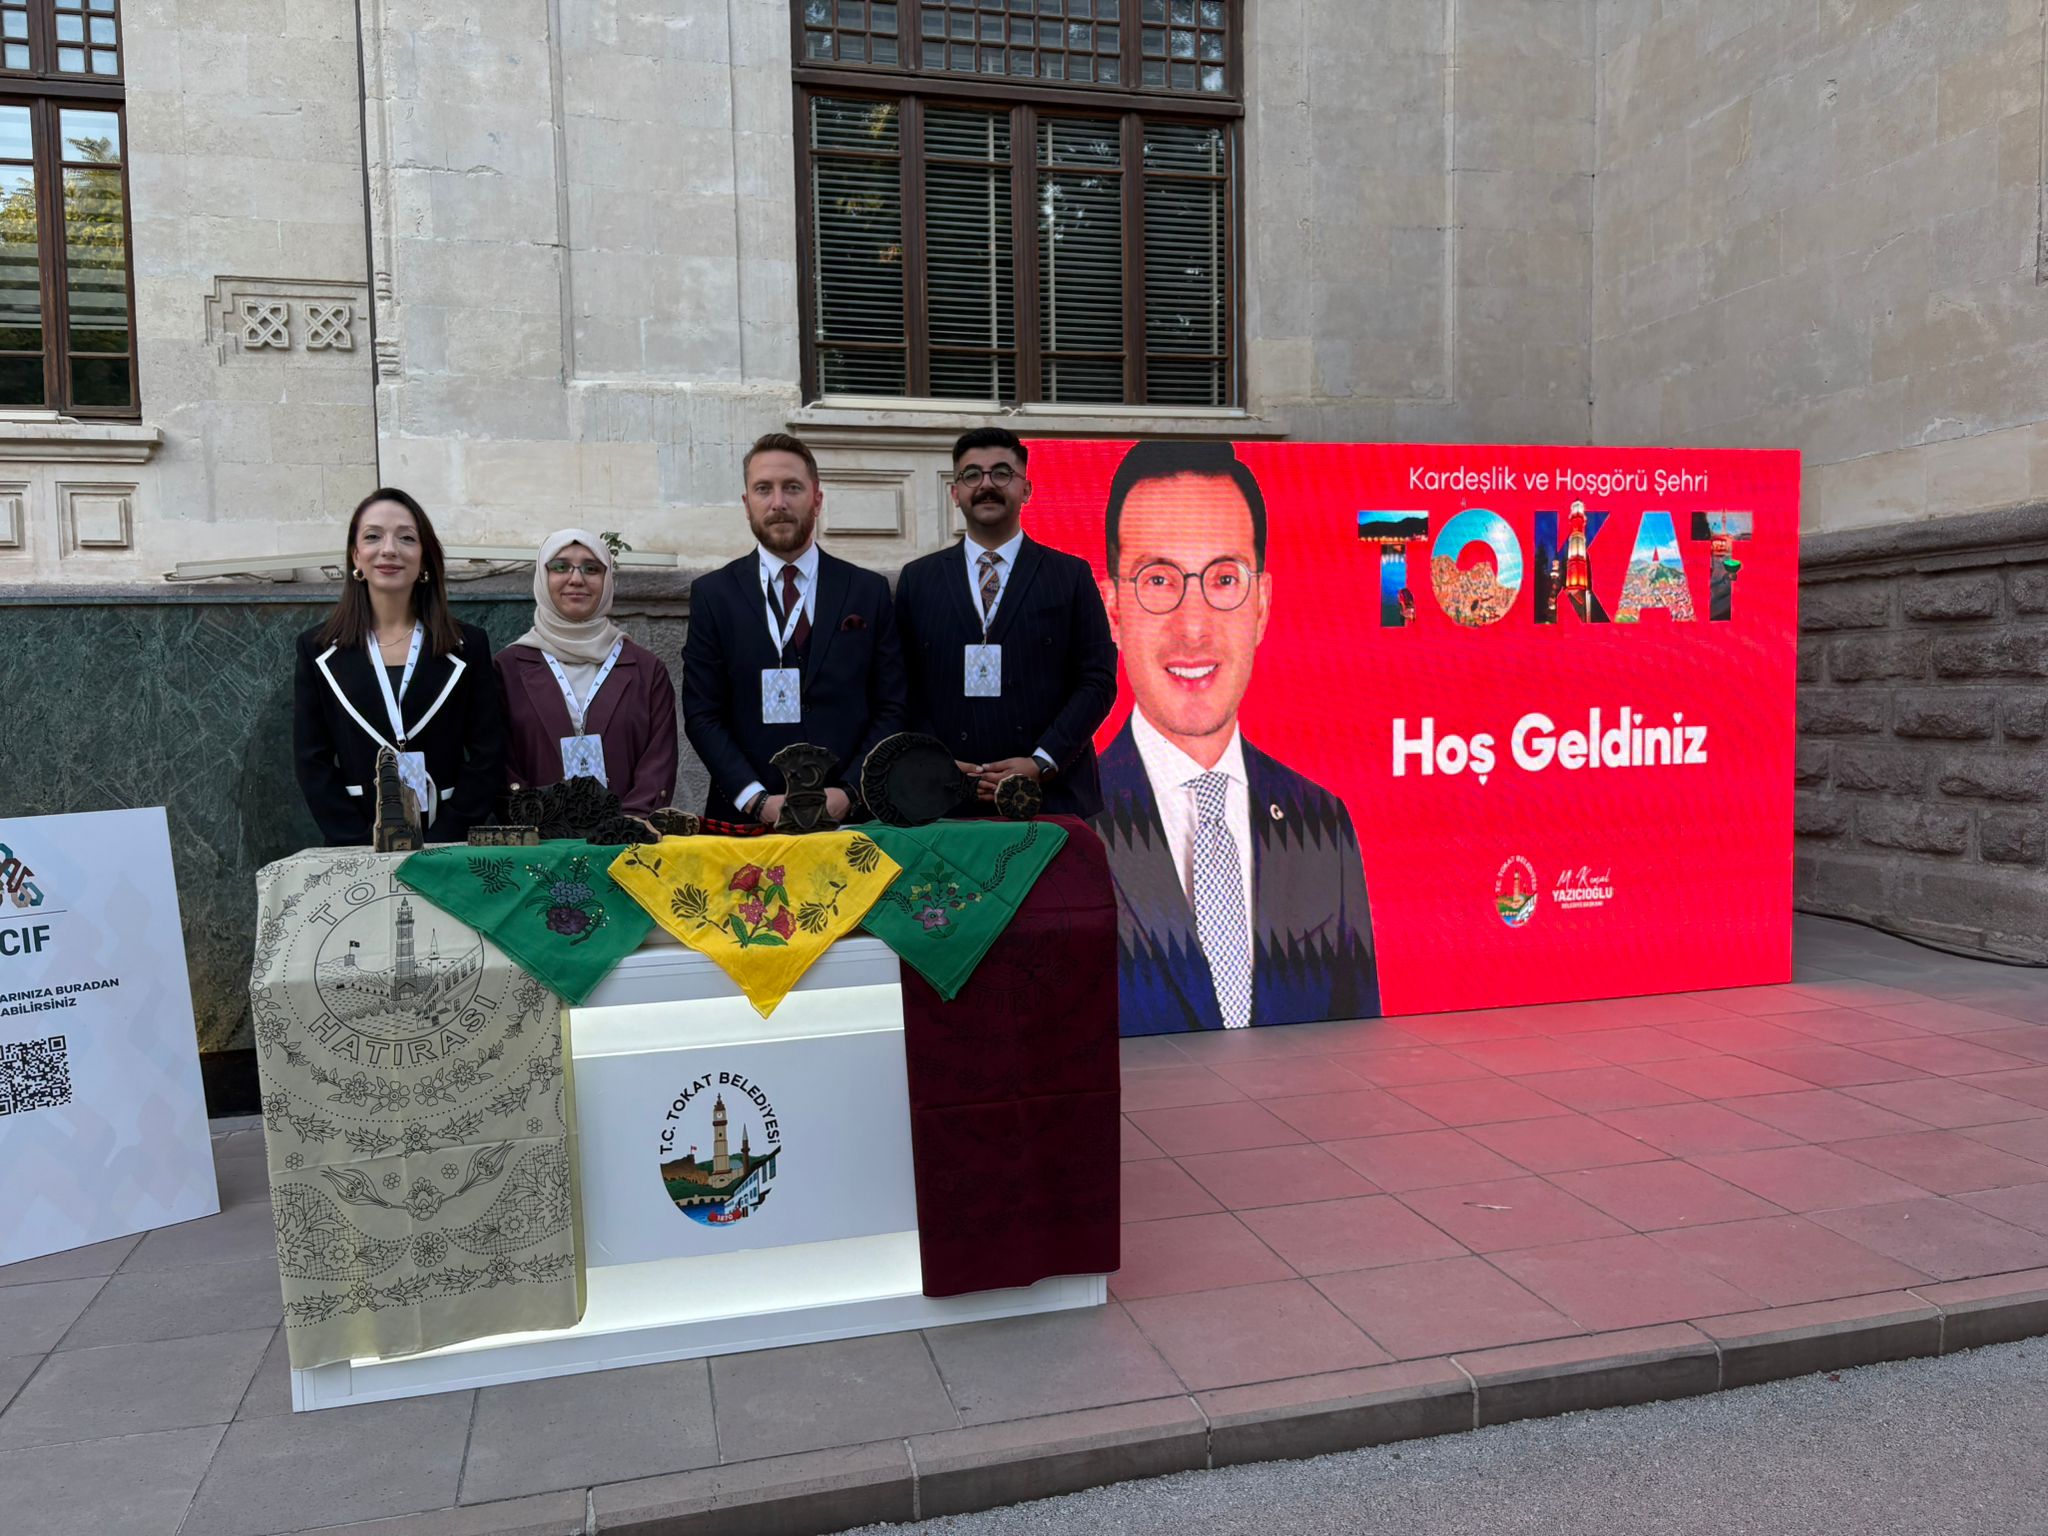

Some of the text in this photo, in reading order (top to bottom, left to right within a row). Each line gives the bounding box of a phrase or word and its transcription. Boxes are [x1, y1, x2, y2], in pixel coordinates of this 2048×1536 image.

[1409, 466, 1708, 497] Kardeşlik ve Hoşgörü Şehri
[1357, 505, 1754, 628] TOKAT
[1391, 706, 1708, 785] Hoş Geldiniz
[1551, 885, 1614, 902] YAZICIOĞLU
[55, 978, 120, 995] BURADAN
[0, 996, 77, 1017] ABİLİRSİNİZ
[308, 994, 498, 1066] HATIRASI
[666, 1073, 713, 1121] TOKAT
